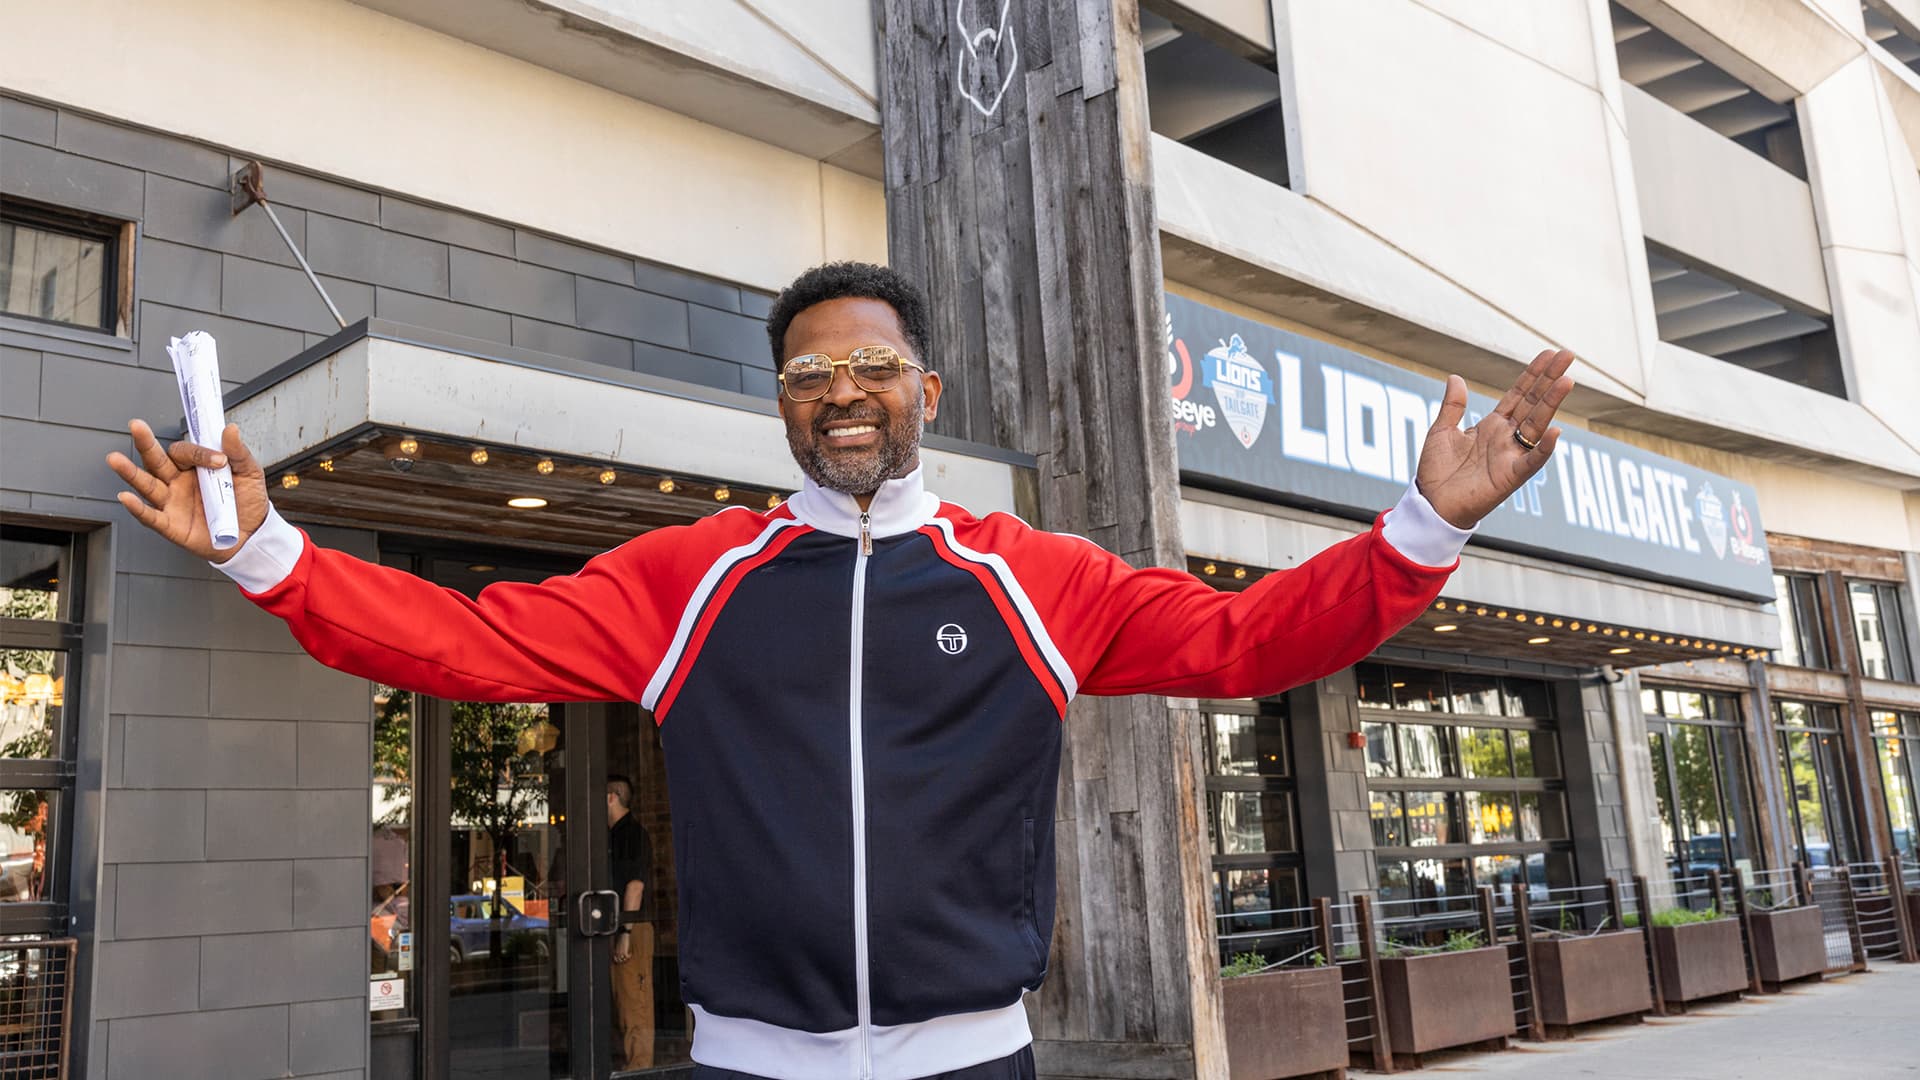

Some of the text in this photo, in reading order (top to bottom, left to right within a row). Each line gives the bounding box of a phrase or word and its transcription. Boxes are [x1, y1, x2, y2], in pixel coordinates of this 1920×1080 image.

[1216, 359, 1262, 392] LIONS
[1172, 398, 1216, 431] seye
[1276, 350, 1443, 486] LION
[1555, 439, 1700, 553] TAILGATE
